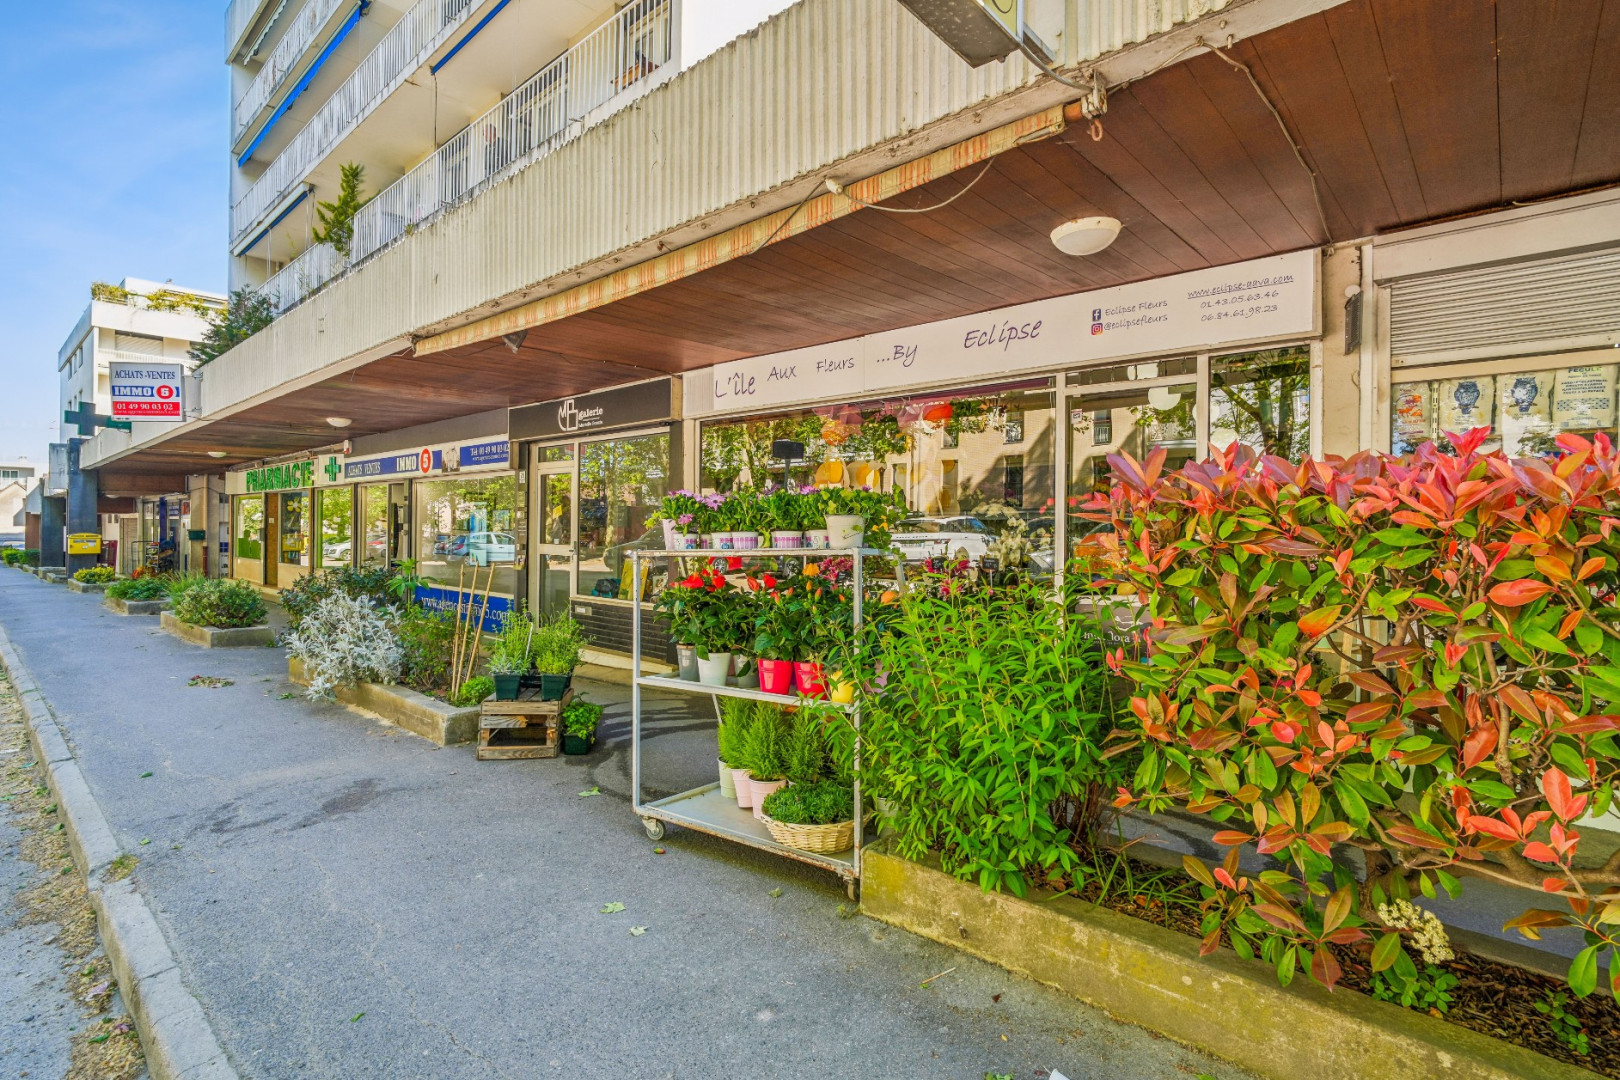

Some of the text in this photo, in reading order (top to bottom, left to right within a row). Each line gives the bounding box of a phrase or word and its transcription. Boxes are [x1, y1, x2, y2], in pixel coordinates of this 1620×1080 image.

[1200, 289, 1279, 309] 01.43.05.63.46
[1105, 300, 1168, 317] Eclipse Fleurs
[1200, 304, 1278, 322] 06.84.61.98.23
[1104, 313, 1168, 331] @eclipsefleurs
[715, 371, 756, 399] L'île
[767, 365, 797, 382] Aux
[816, 357, 856, 373] Fleurs
[963, 320, 1043, 352] Eclipse
[114, 386, 151, 396] IMMO
[578, 406, 604, 421] galerie
[396, 455, 417, 472] IMMO
[422, 454, 429, 468] 5
[246, 461, 314, 492] PHARMACIE
